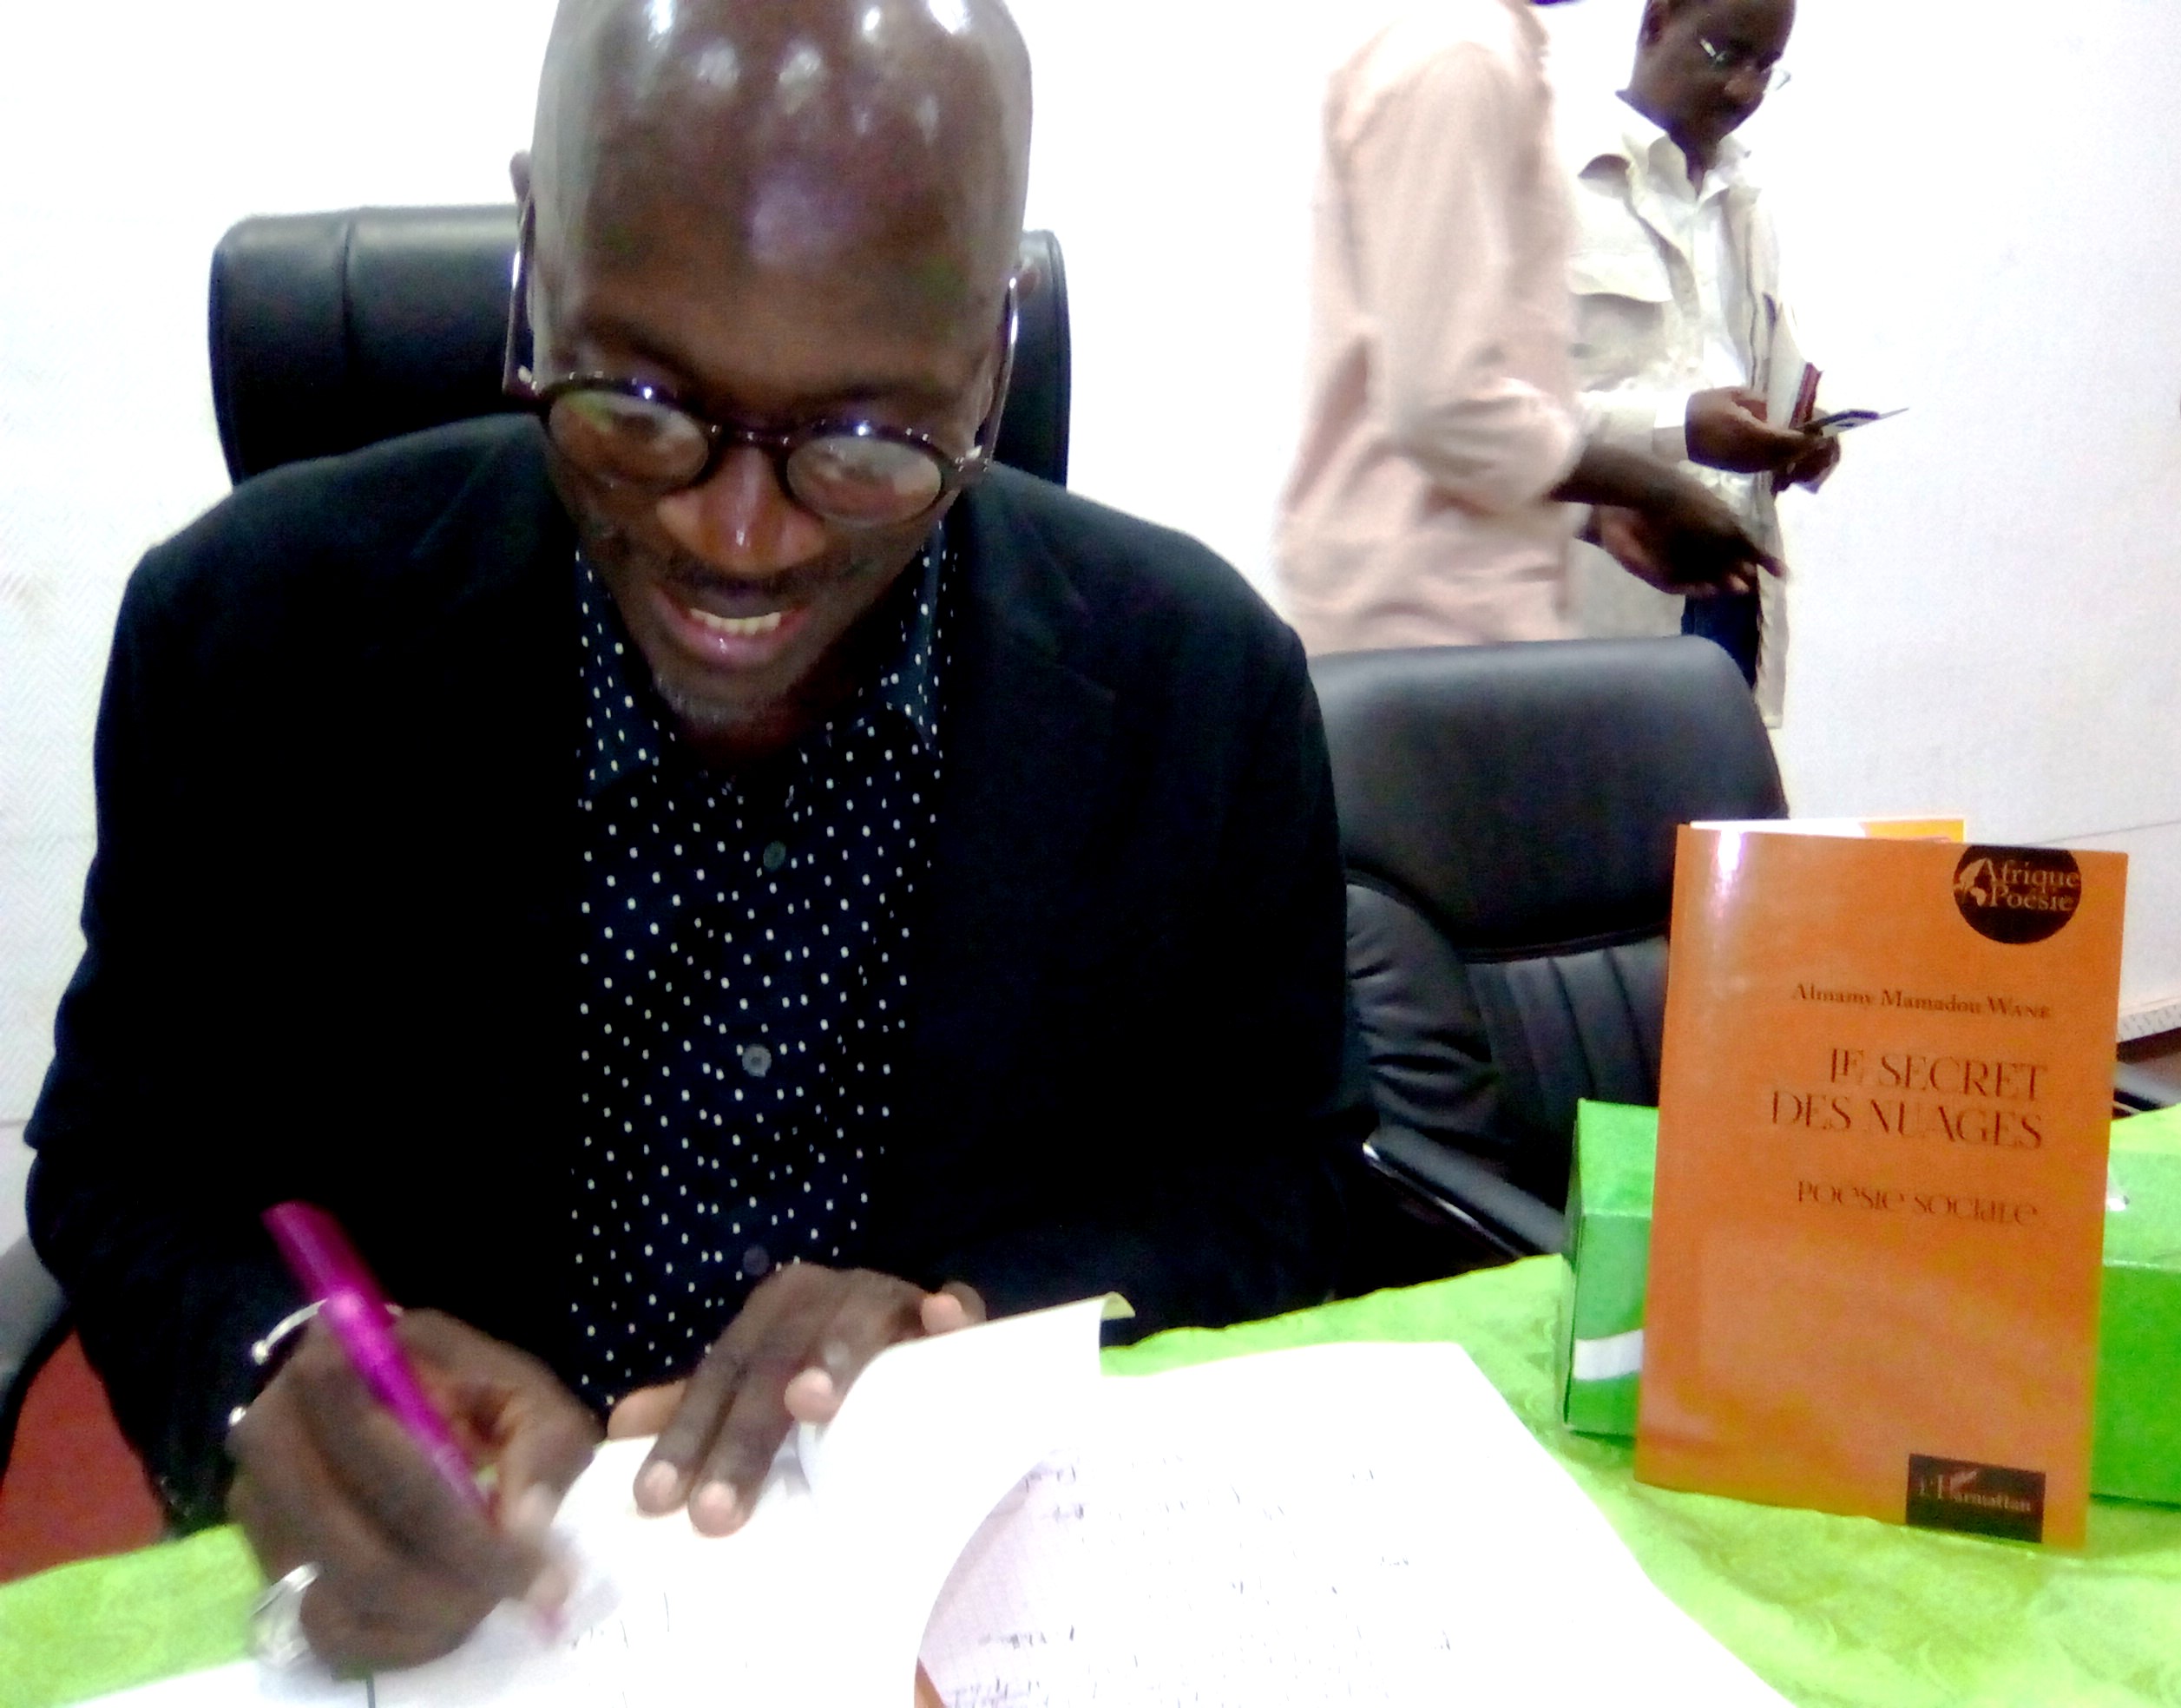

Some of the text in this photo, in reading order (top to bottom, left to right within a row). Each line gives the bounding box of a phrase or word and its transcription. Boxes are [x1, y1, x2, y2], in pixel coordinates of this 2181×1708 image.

[1960, 857, 2079, 894] Afrique
[1881, 989, 1981, 1014] Mamadou
[1831, 1048, 2046, 1101] LE SECRET
[1772, 1090, 2041, 1149] DES NUAGES
